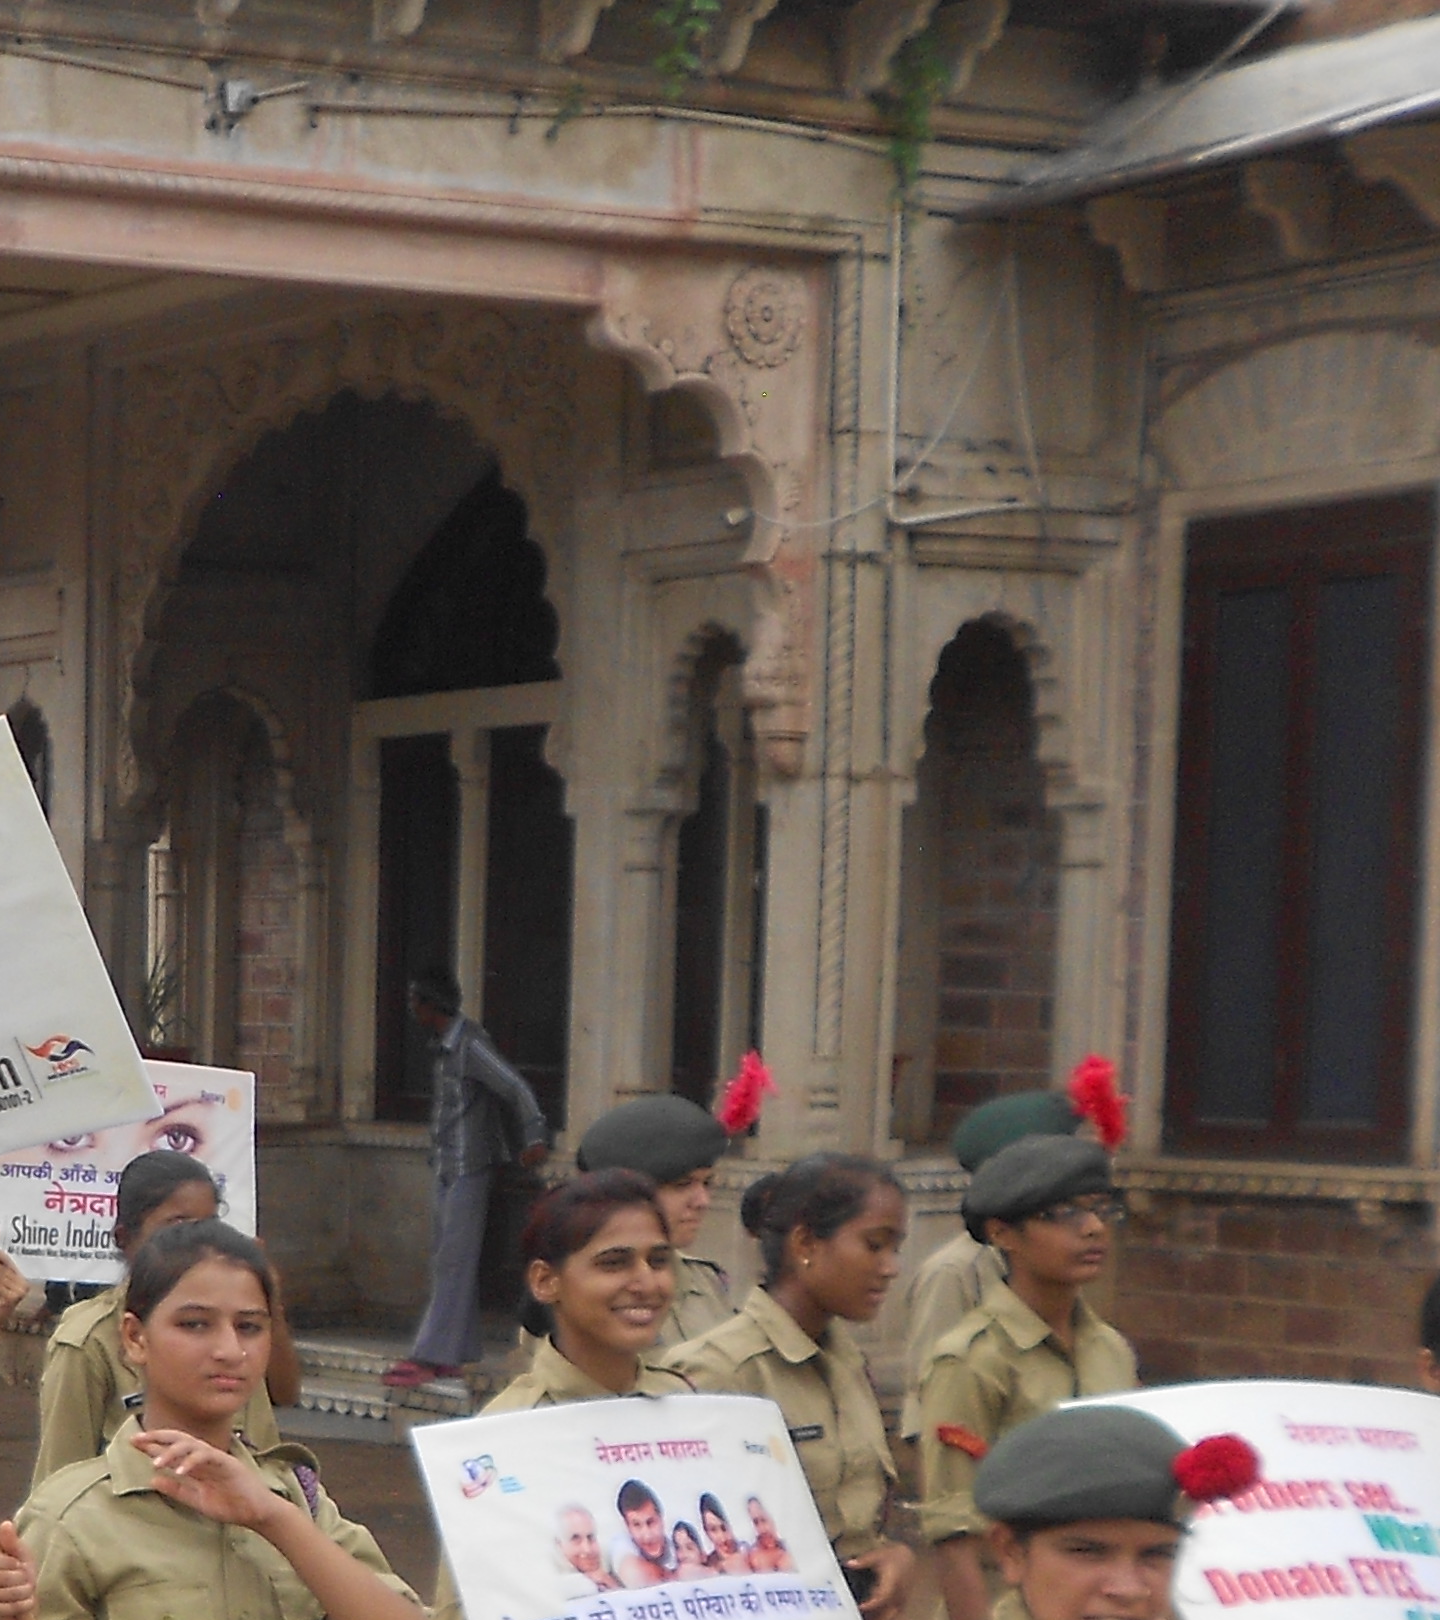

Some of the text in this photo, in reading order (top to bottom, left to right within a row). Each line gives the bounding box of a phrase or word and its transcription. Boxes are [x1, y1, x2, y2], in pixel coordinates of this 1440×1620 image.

[0, 1161, 52, 1181] आपकी
[59, 1162, 98, 1184] आँखे
[44, 1180, 120, 1218] नेत्रदा
[11, 1214, 111, 1249] Shine India
[1363, 1513, 1440, 1556] Wha
[1204, 1562, 1350, 1608] Donate
